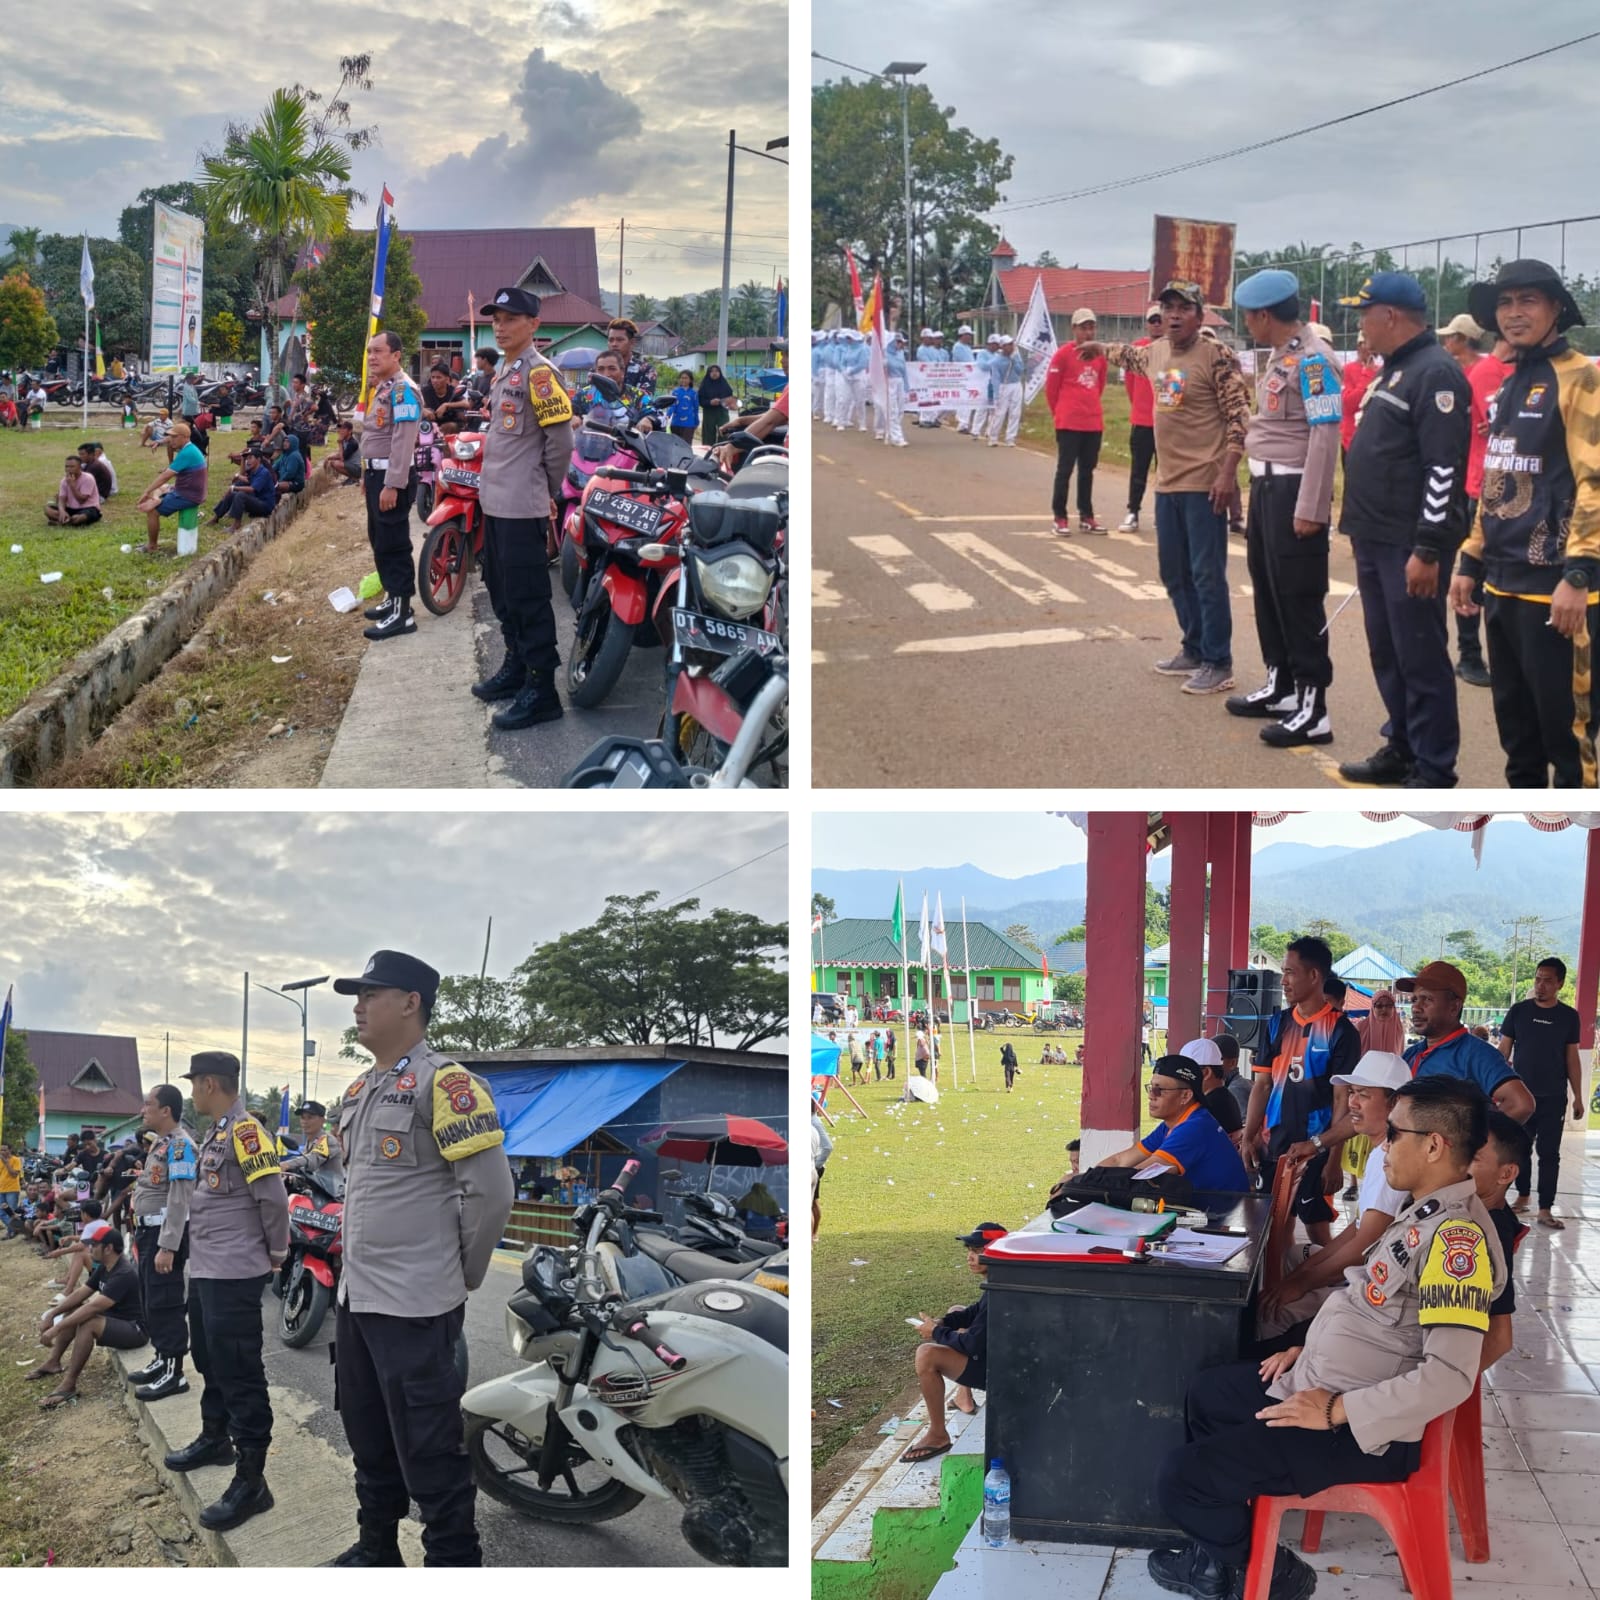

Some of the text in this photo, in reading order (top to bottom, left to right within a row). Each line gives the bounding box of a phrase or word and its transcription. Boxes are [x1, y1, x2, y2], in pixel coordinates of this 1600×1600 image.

[502, 388, 524, 399] POLRI
[610, 499, 639, 514] 4397
[641, 510, 658, 522] AE
[676, 613, 697, 629] DT
[705, 619, 747, 641] 5865
[1288, 1055, 1305, 1083] 5
[380, 1094, 414, 1105] POLRI
[1390, 1240, 1410, 1268] POLRI
